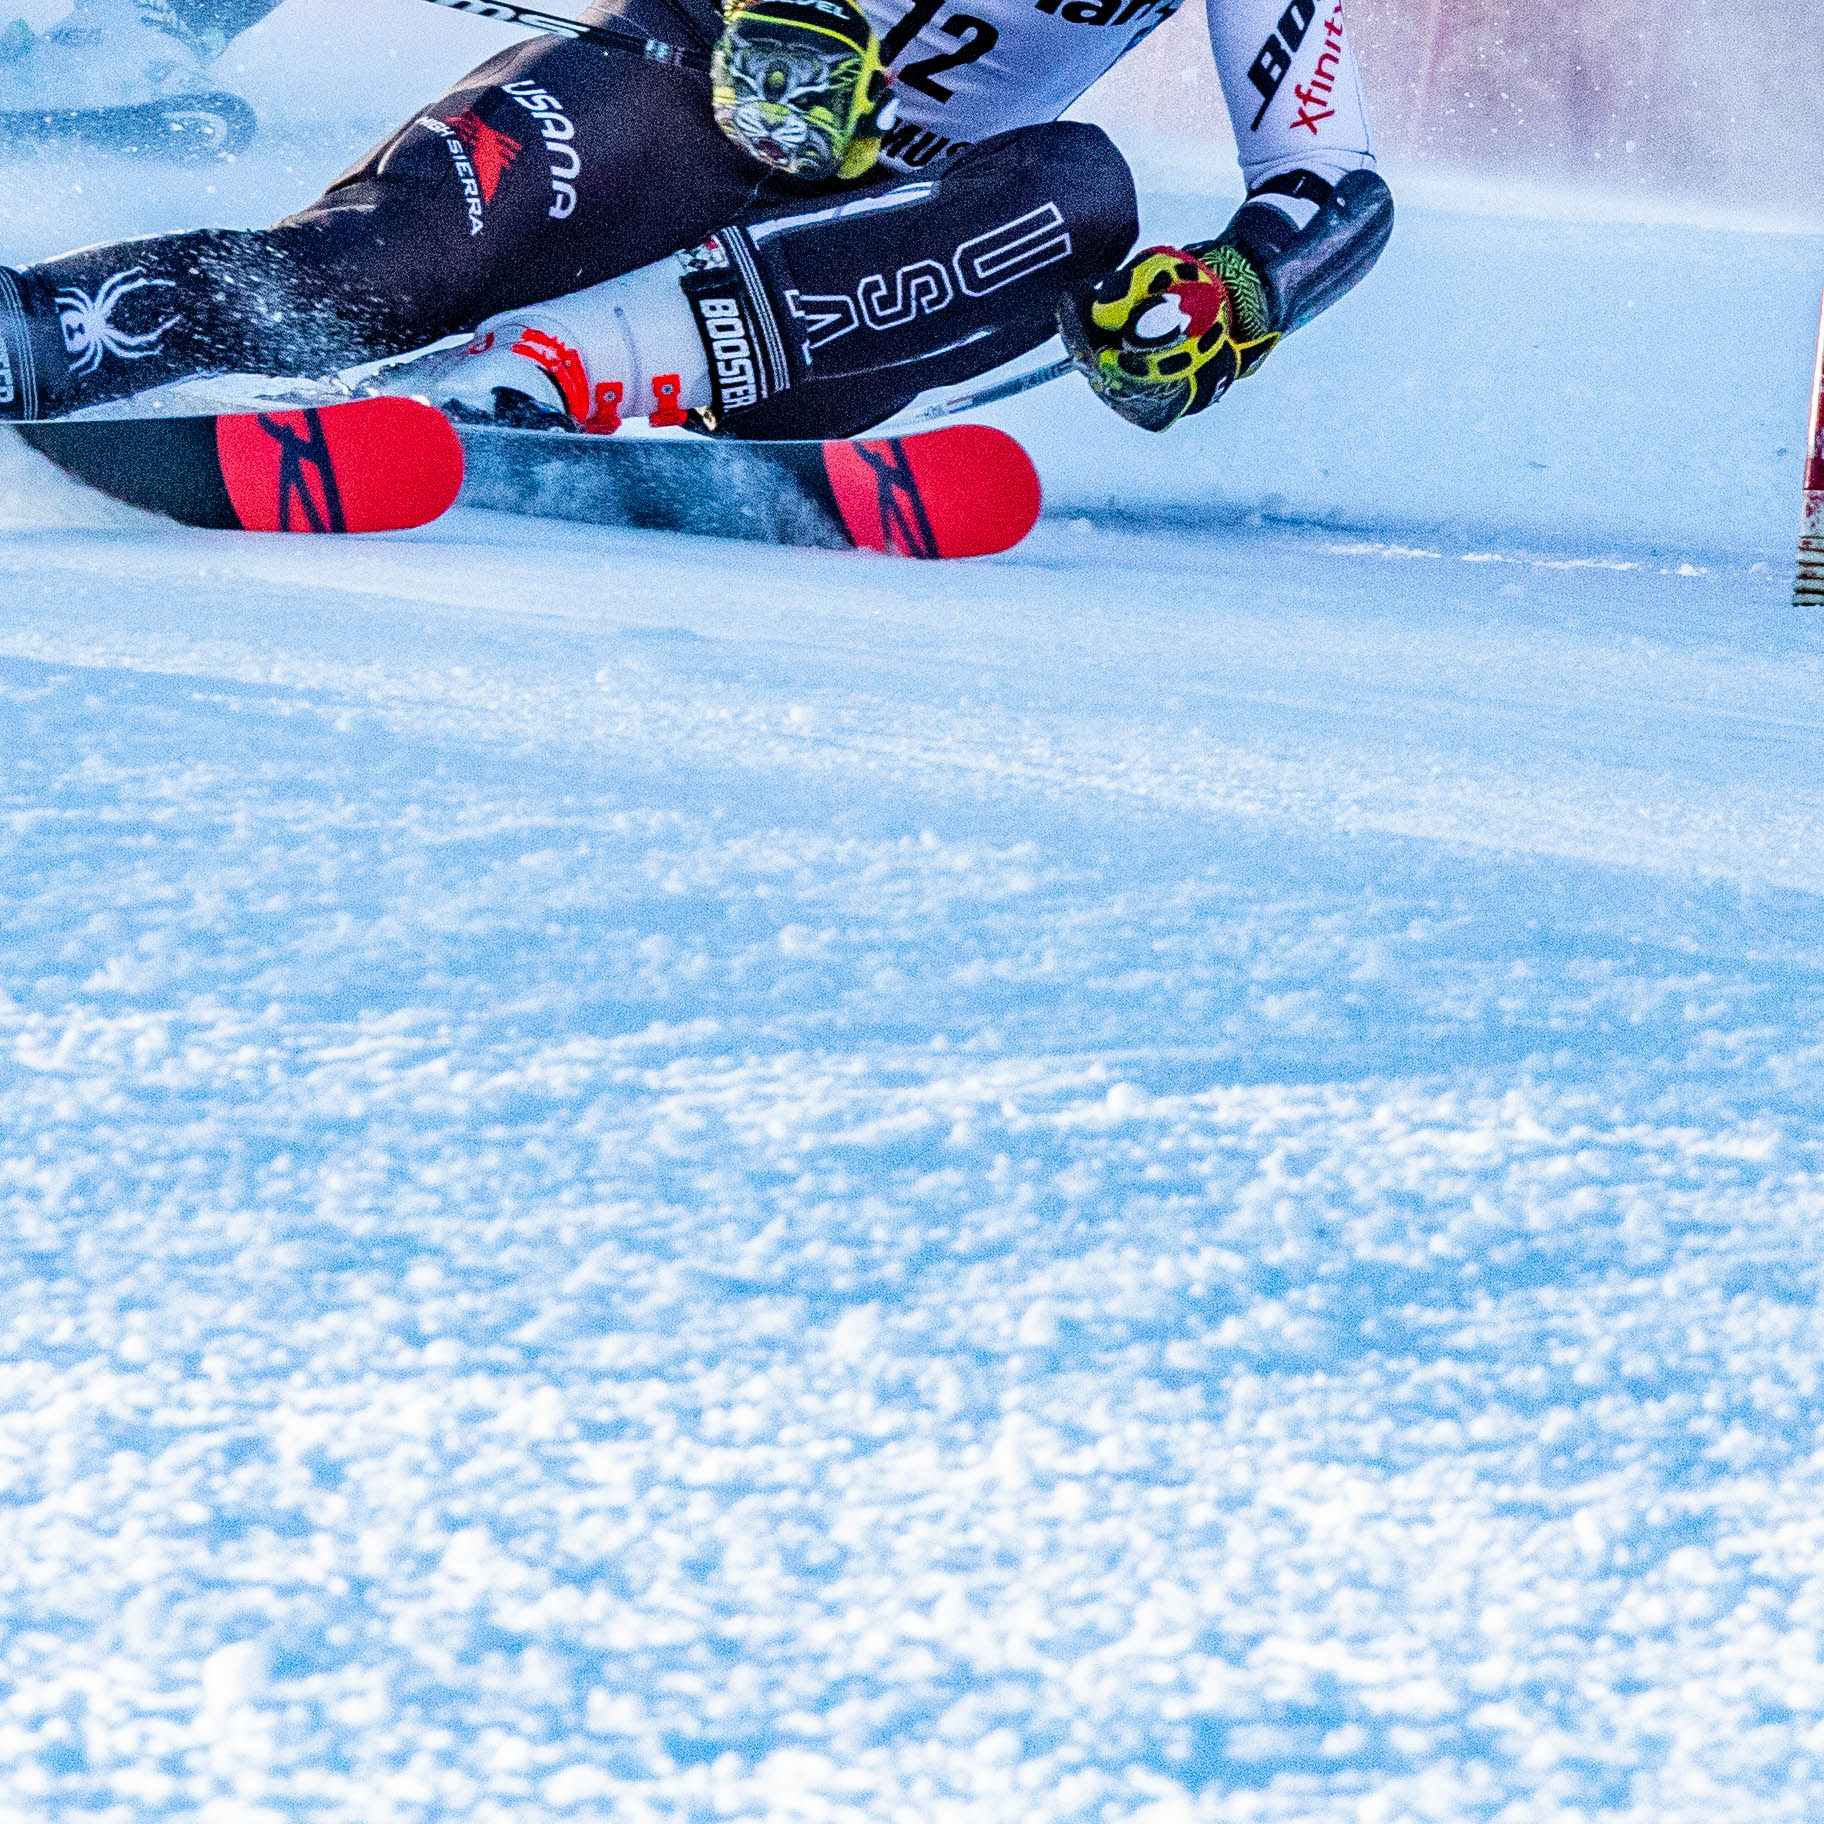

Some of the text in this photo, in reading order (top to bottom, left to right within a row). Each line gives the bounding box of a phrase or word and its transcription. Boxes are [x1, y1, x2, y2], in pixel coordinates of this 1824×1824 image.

[446, 138, 485, 237] SIERRA
[501, 79, 582, 220] USANA
[783, 201, 1073, 366] USA
[698, 297, 759, 412] BOOSTER
